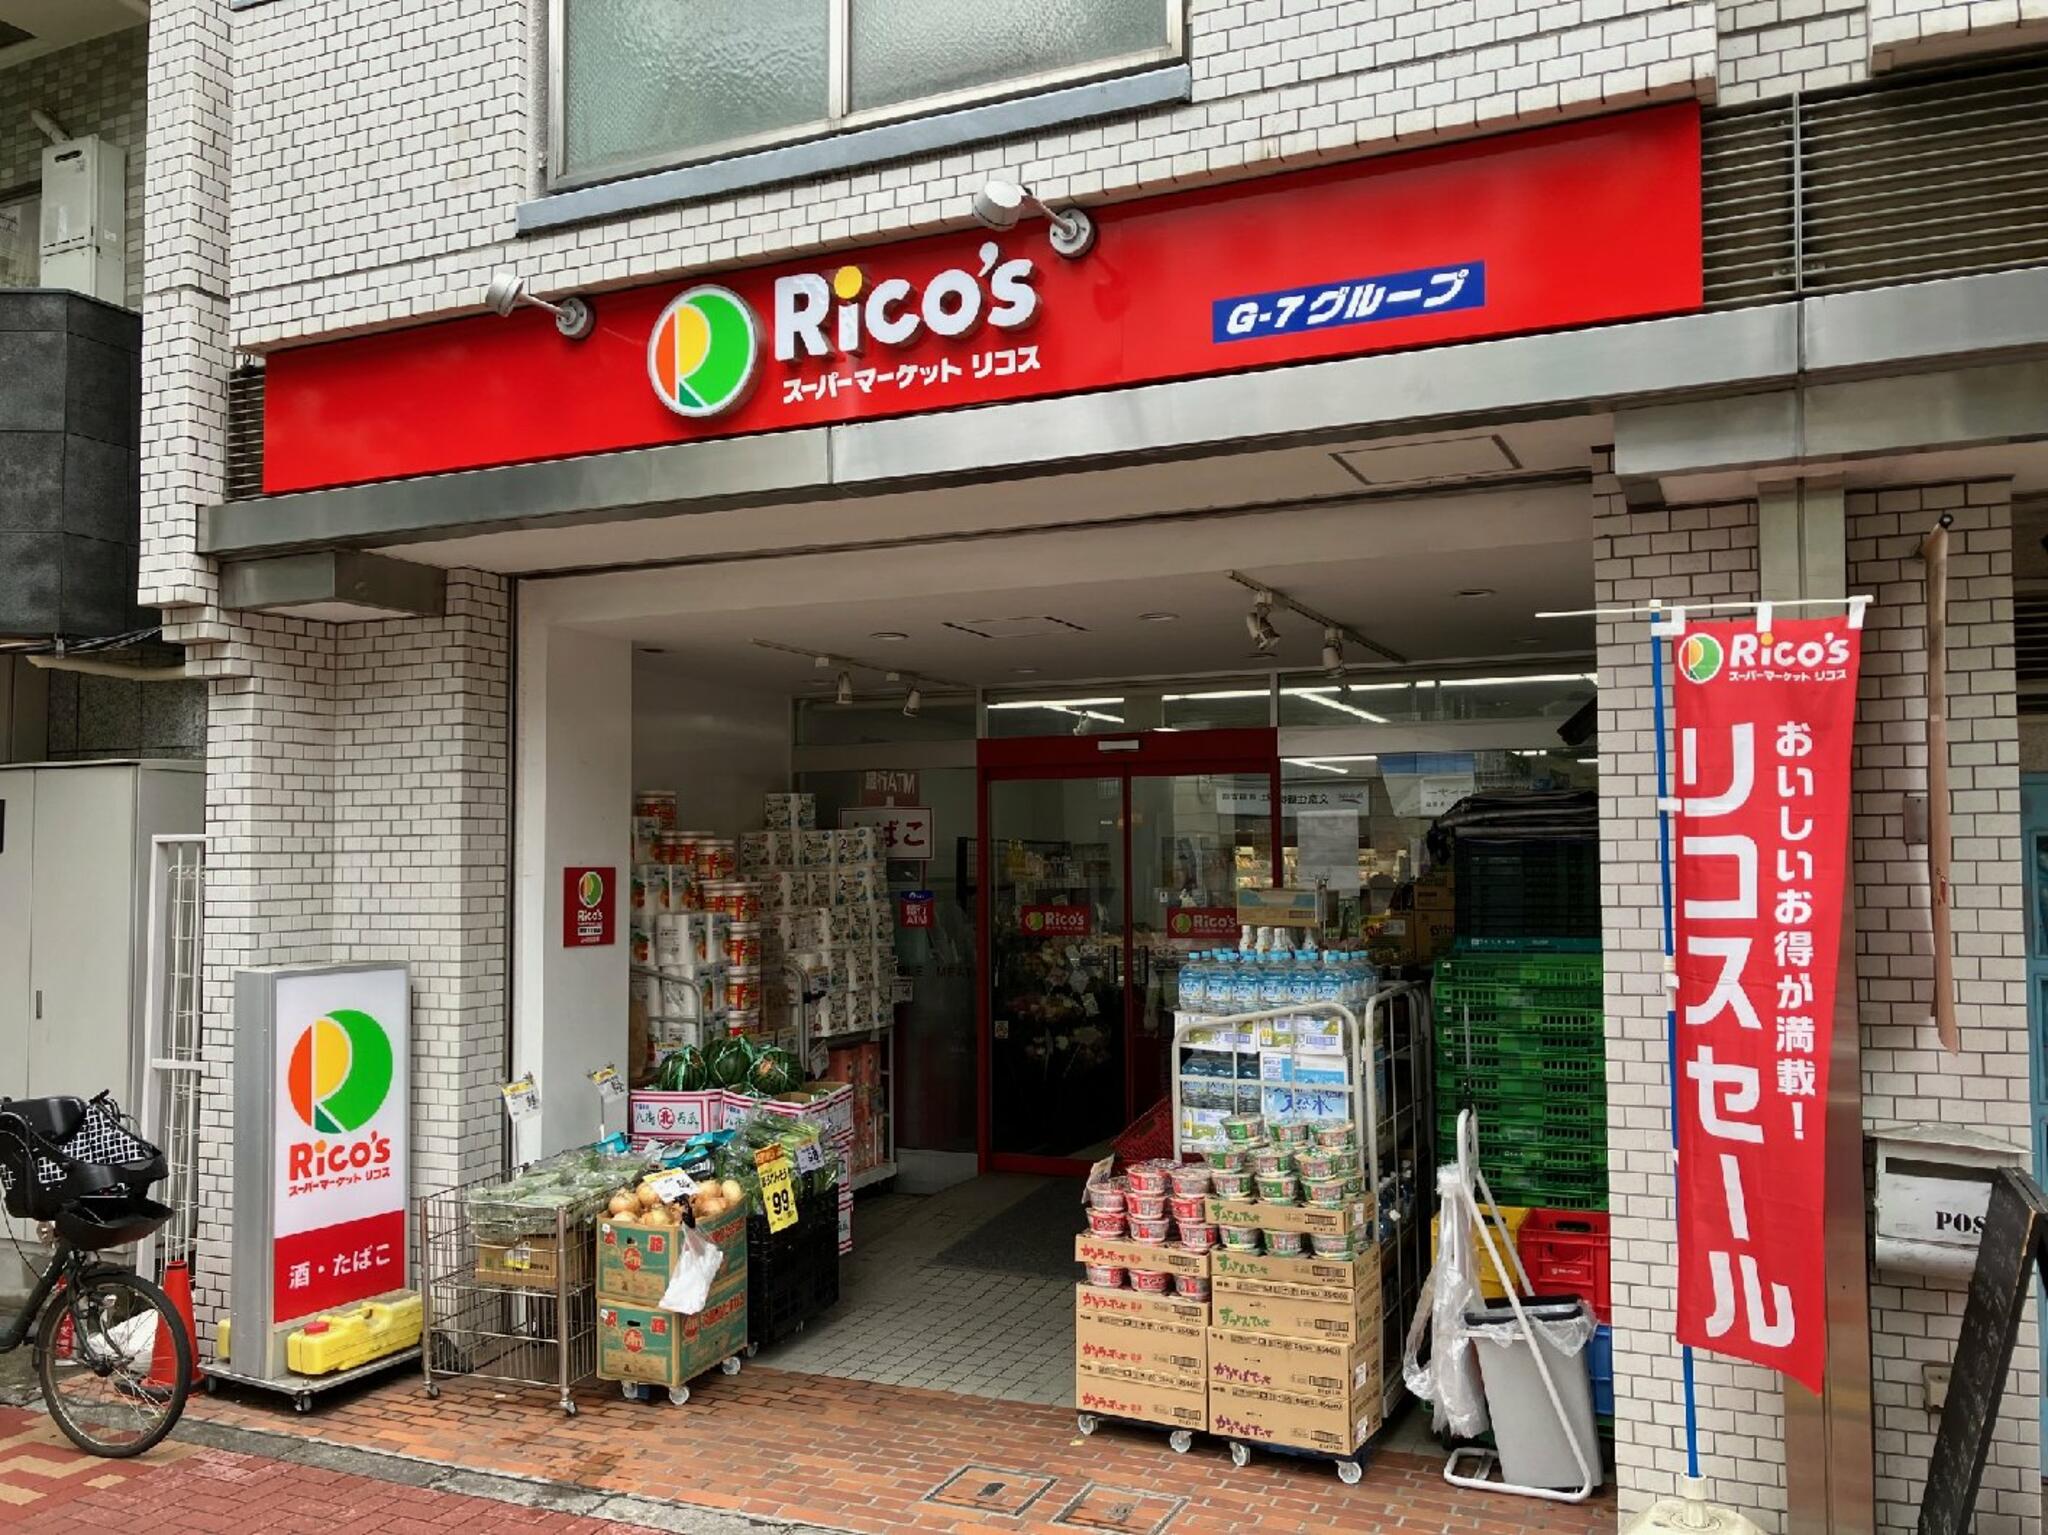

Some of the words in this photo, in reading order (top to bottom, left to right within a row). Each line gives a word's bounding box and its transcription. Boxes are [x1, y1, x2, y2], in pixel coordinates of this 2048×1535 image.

[774, 241, 1038, 361] Rico's
[1226, 269, 1469, 335] G-7グループ
[783, 358, 962, 404] スーパーマーケット
[972, 346, 1041, 379] リコス
[1729, 632, 1849, 668] Rico's
[1729, 670, 1811, 682] スーパーマーケット
[1814, 668, 1847, 681] リコス
[577, 908, 603, 921] Rico's
[1044, 911, 1085, 927] Rico's
[1192, 914, 1237, 928] Rico's
[1774, 720, 1816, 1140] おいしいお得が満載！
[1682, 722, 1796, 1347] リコスセール
[288, 1131, 391, 1181] Rico's
[288, 1174, 362, 1197] スーパーマーケット
[365, 1166, 391, 1181] リコス
[772, 1187, 789, 1215] 99
[288, 1242, 391, 1290] 酒・たばこ
